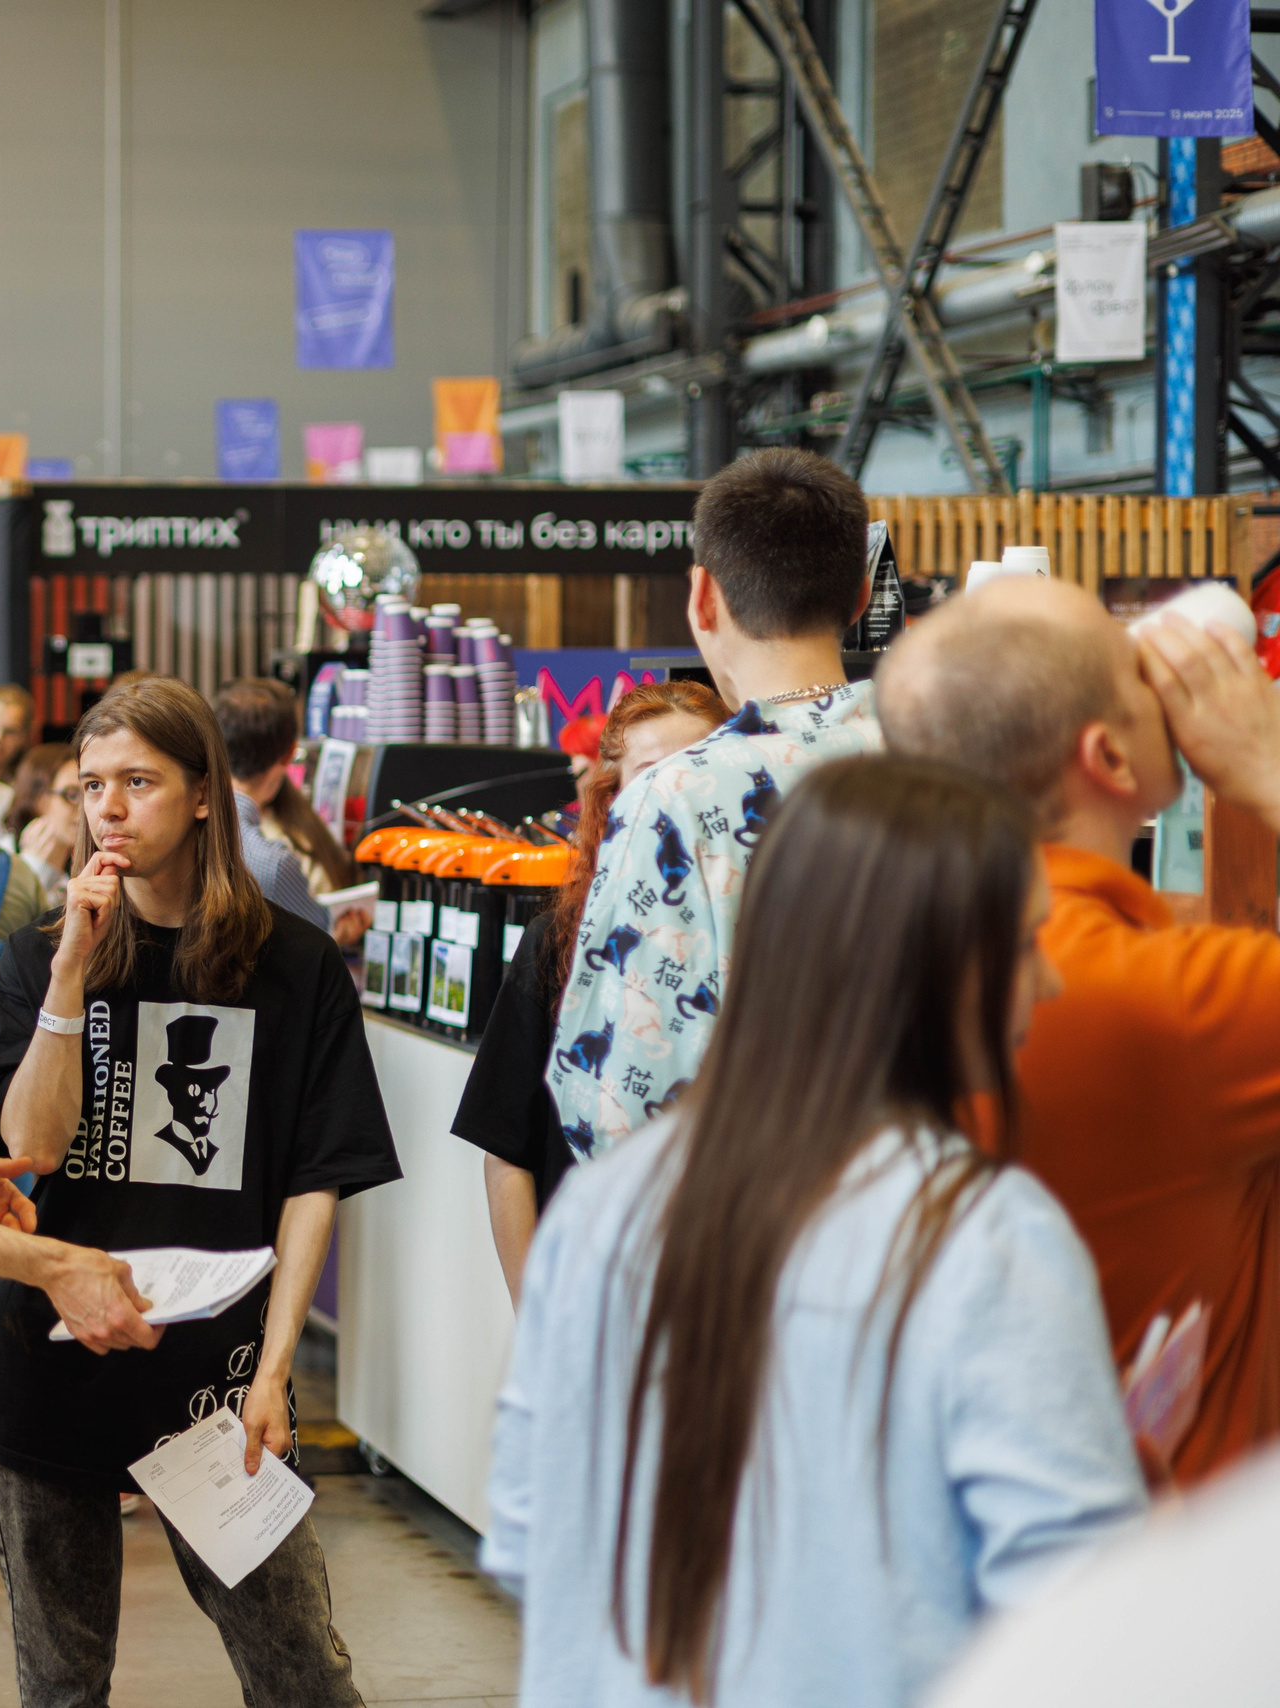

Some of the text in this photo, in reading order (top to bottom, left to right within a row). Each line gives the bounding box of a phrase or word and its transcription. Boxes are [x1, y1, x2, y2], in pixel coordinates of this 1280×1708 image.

[1183, 110, 1213, 120] июля
[1215, 108, 1244, 119] 2025
[76, 515, 243, 558] триптих
[408, 518, 471, 550] кто
[474, 518, 524, 550] ты
[530, 511, 597, 550] без
[695, 805, 730, 840] 猫
[626, 879, 659, 917] 猫
[653, 955, 688, 992] 猫
[85, 1000, 111, 1180] FASHIONED
[621, 1063, 655, 1100] 猫
[105, 1061, 133, 1182] COFFEE
[65, 1116, 89, 1180] OLD
